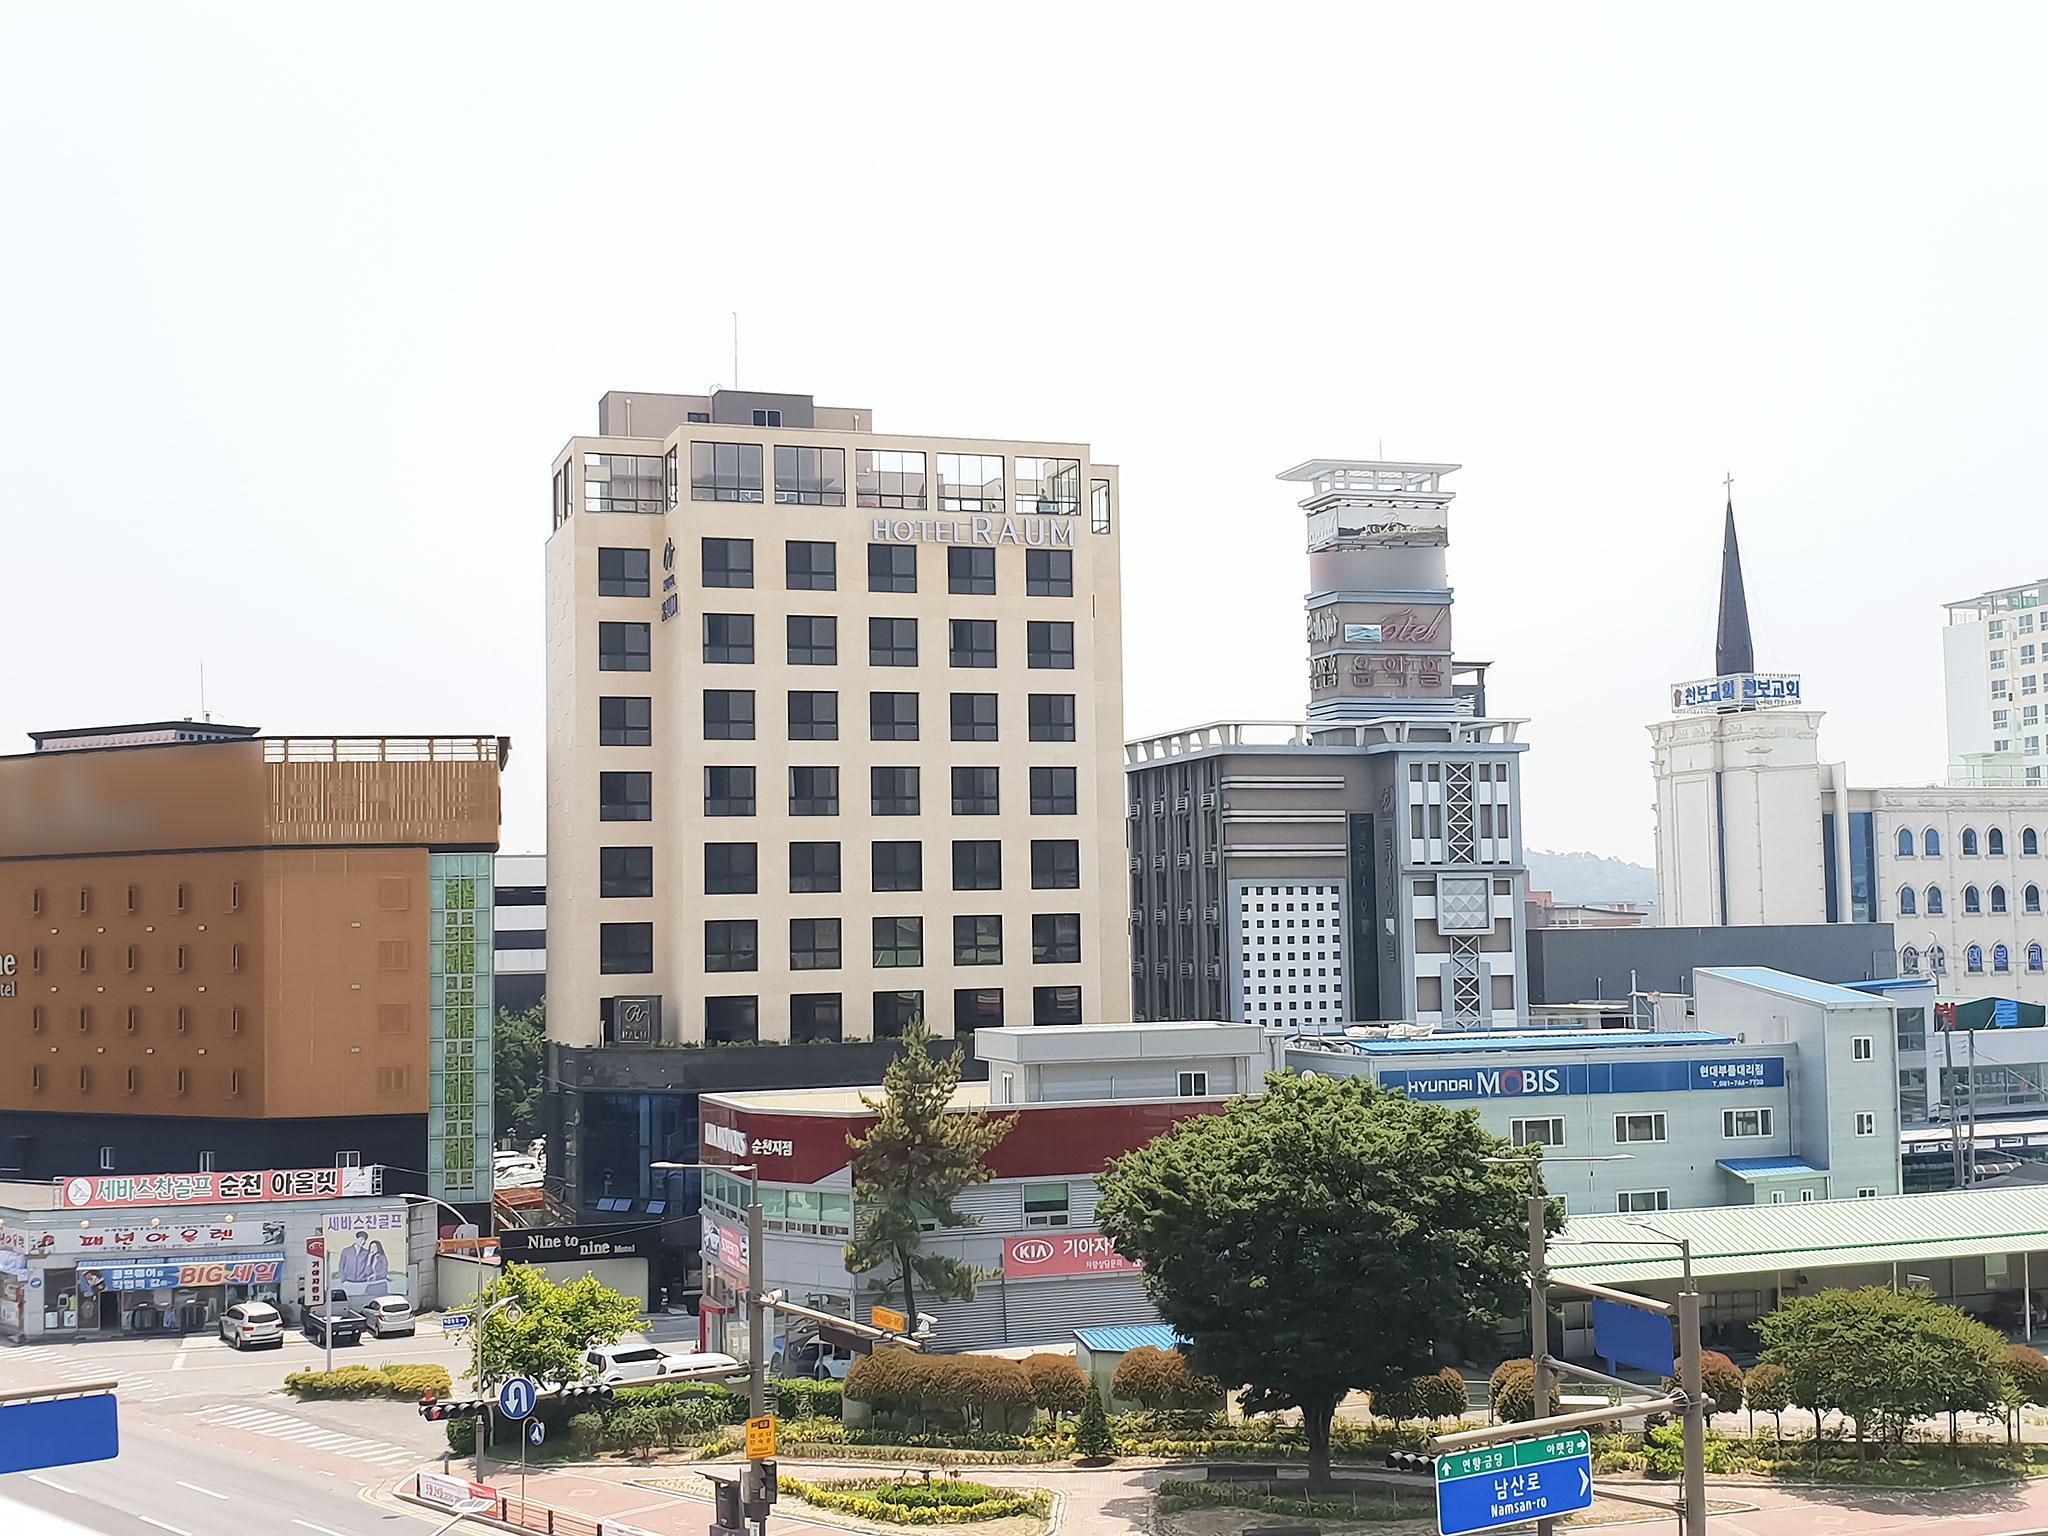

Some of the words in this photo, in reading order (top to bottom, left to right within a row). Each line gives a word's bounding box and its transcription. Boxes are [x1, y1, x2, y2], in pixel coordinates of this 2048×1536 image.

[873, 519, 968, 543] HOTEL
[971, 516, 1075, 546] RAUM
[1408, 1079, 1472, 1092] HYUNDAI
[1476, 1069, 1560, 1095] MOBIS
[751, 1138, 793, 1157] 순천지점
[96, 1175, 212, 1202] 세바스찬골프
[218, 1174, 262, 1197] 순천
[271, 1170, 337, 1195] 아울렛
[328, 1214, 402, 1231] 세바스찬골프
[527, 1235, 561, 1249] Nine
[564, 1234, 579, 1247] to
[580, 1240, 610, 1256] nine
[1019, 1244, 1048, 1259] KIA
[179, 1264, 224, 1286] BIG
[225, 1261, 279, 1285] 세일
[1546, 1440, 1576, 1456] 아랫장
[1494, 1472, 1542, 1501] 남산로
[1490, 1497, 1548, 1518] Namsan-ro
